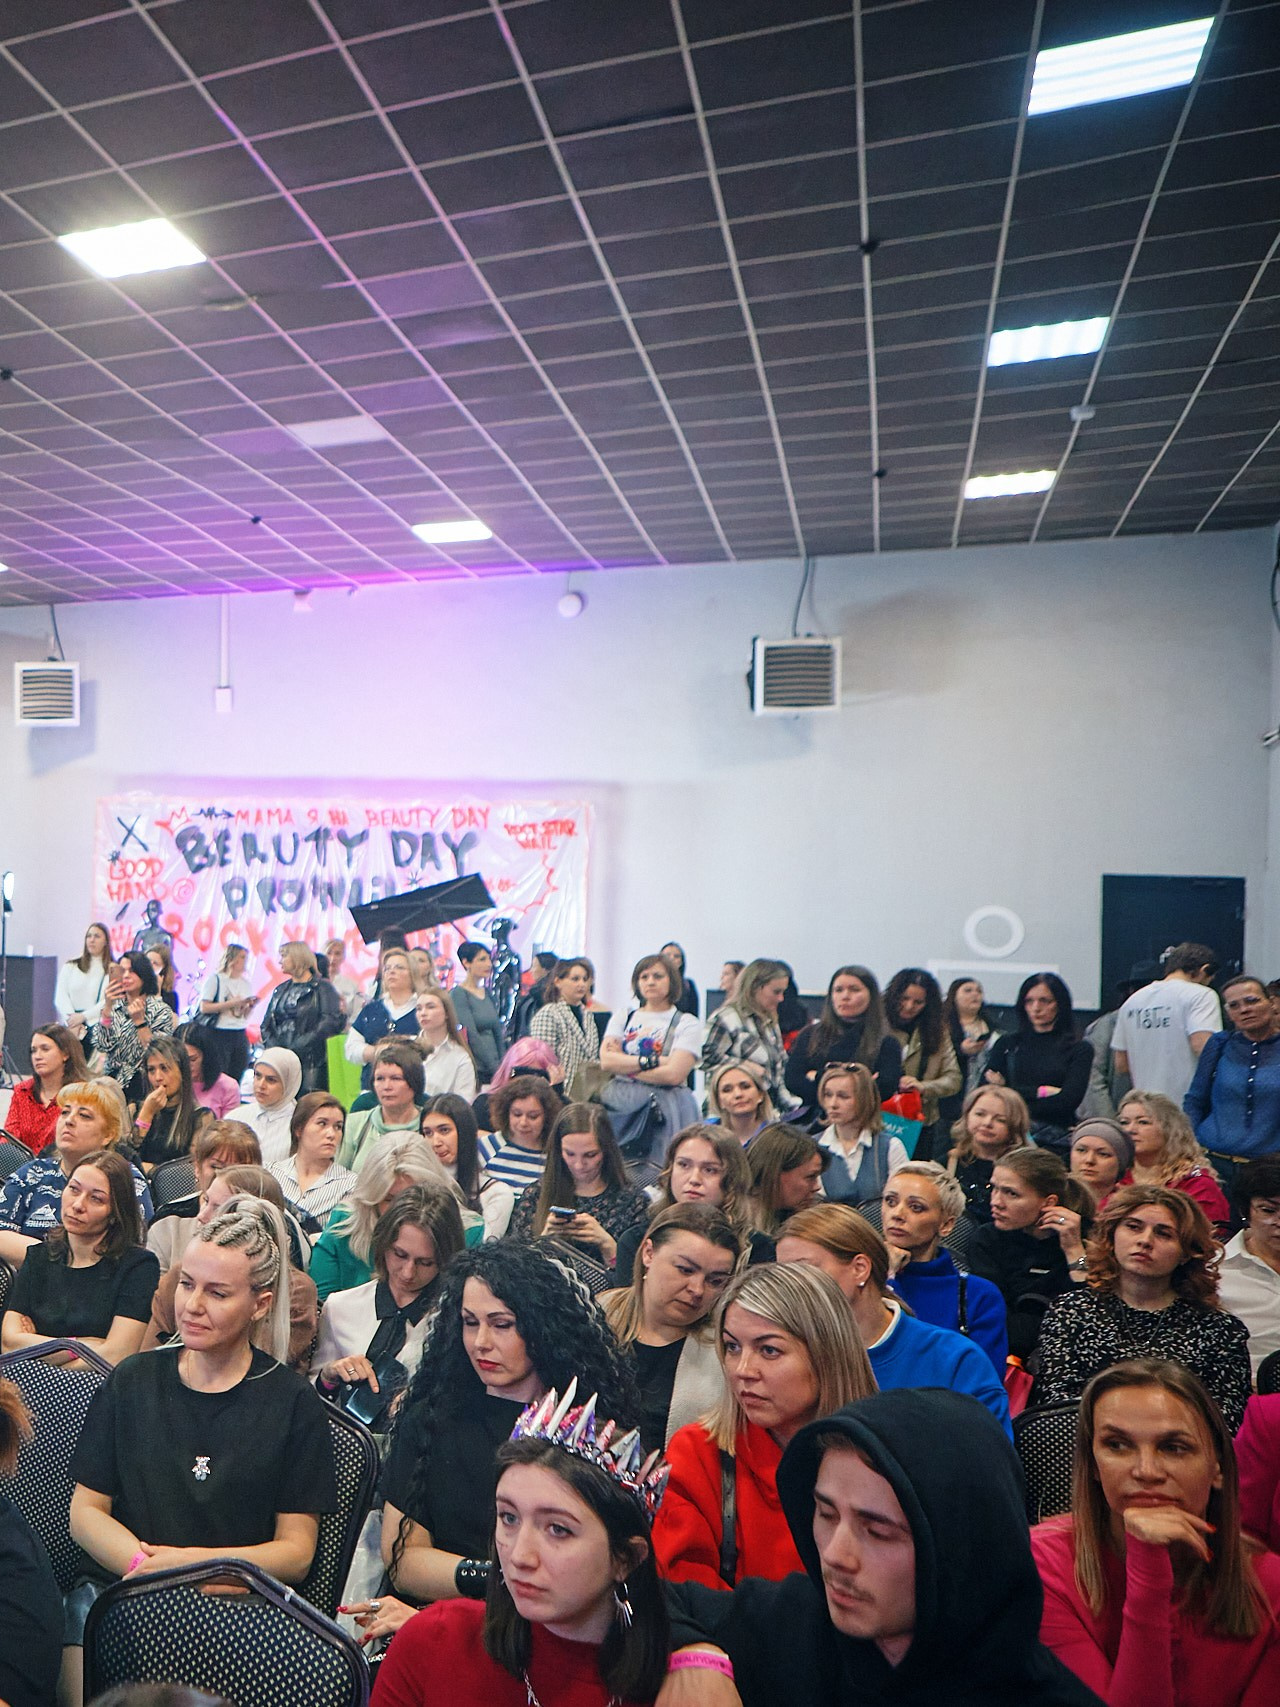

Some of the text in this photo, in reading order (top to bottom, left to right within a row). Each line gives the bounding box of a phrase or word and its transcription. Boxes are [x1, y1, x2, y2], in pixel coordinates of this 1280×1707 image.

[365, 806, 491, 829] BEAUTY DAY
[175, 825, 479, 876] BEAUTY DAY
